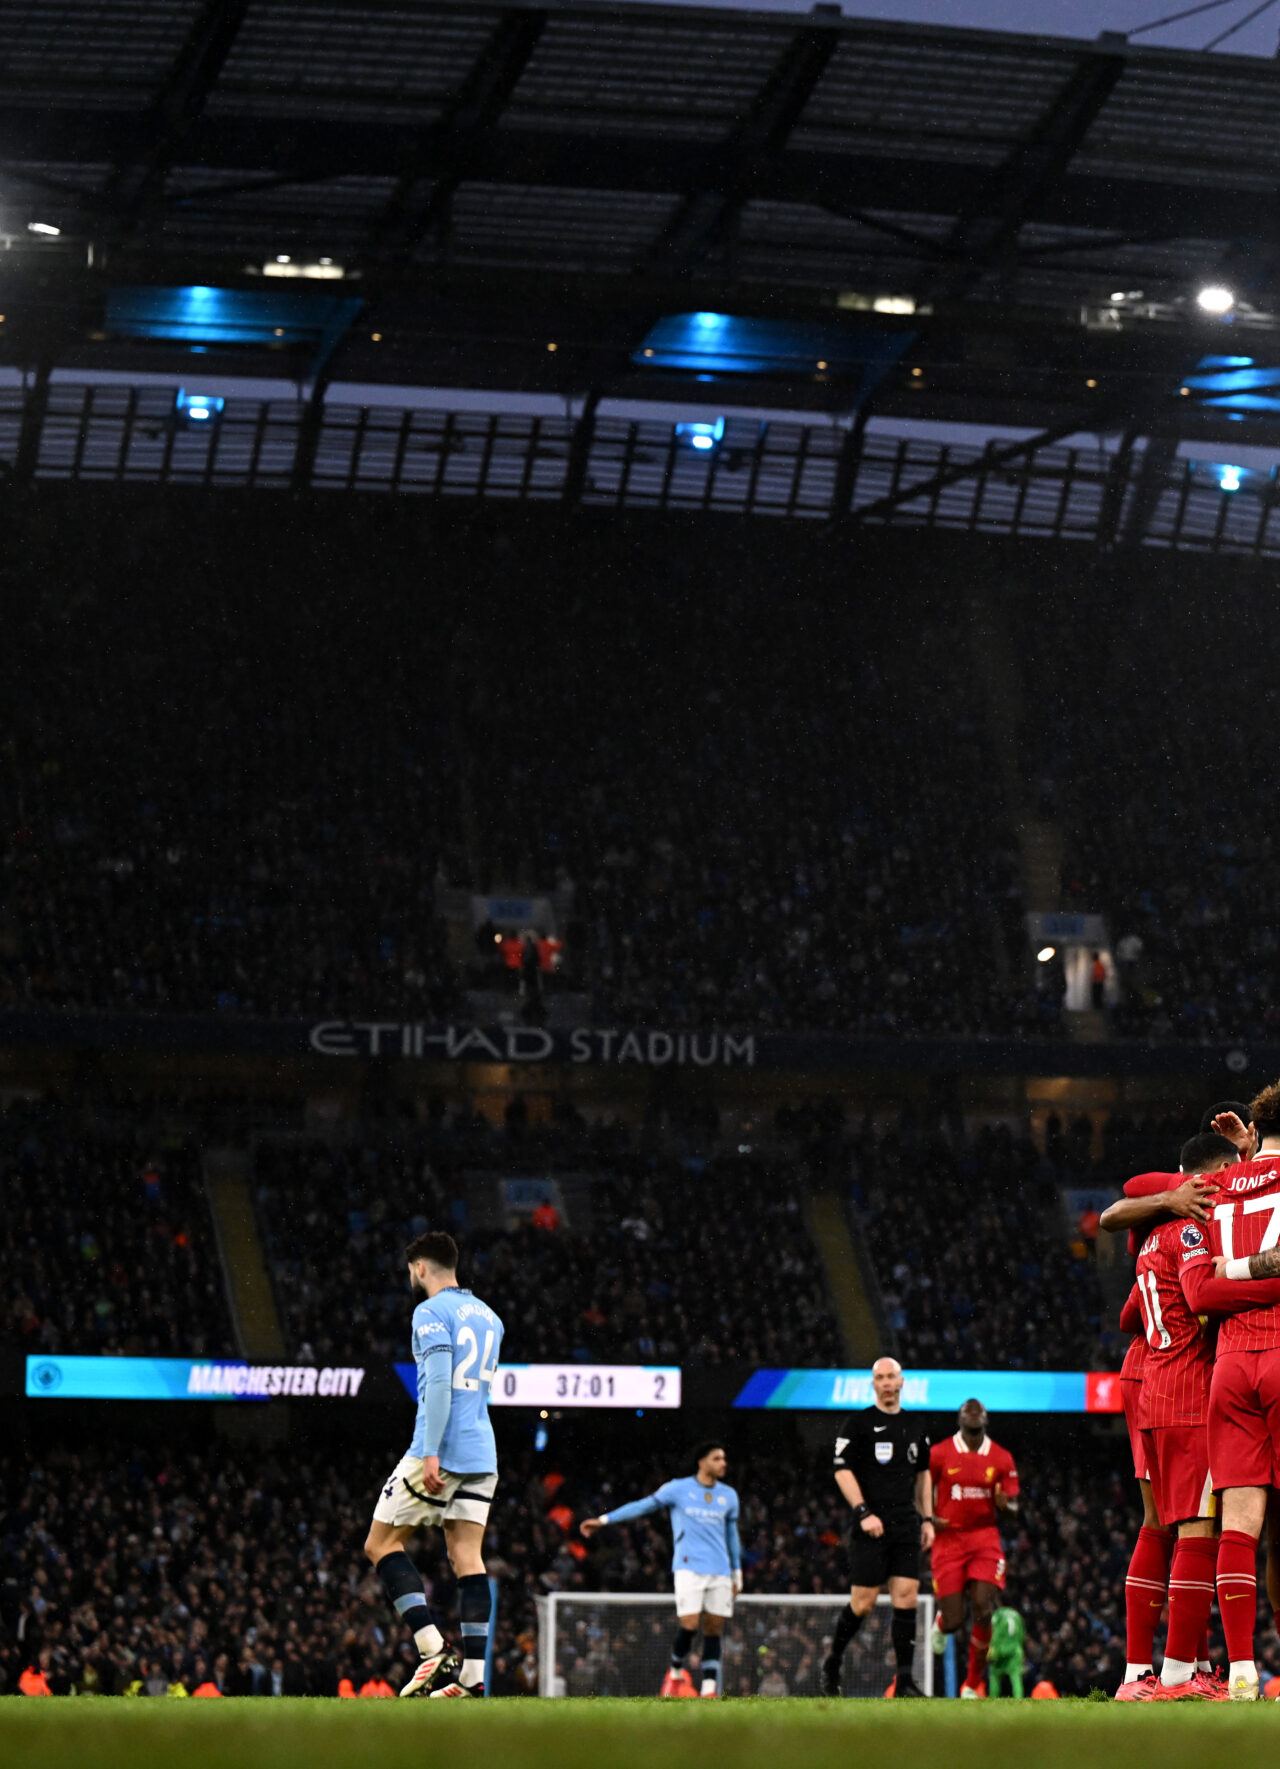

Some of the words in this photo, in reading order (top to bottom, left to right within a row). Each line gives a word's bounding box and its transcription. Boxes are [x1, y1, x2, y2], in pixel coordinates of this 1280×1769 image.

[308, 1020, 554, 1062] ETIHAD
[569, 1028, 757, 1066] STADIUM
[1227, 1170, 1278, 1192] JONES
[1137, 1270, 1172, 1350] 11
[452, 1325, 499, 1394] 24
[187, 1364, 318, 1396] MANCHESTER
[317, 1366, 366, 1397] CITY
[503, 1372, 517, 1398] 0
[556, 1373, 616, 1398] 37:01
[653, 1375, 667, 1400] 2
